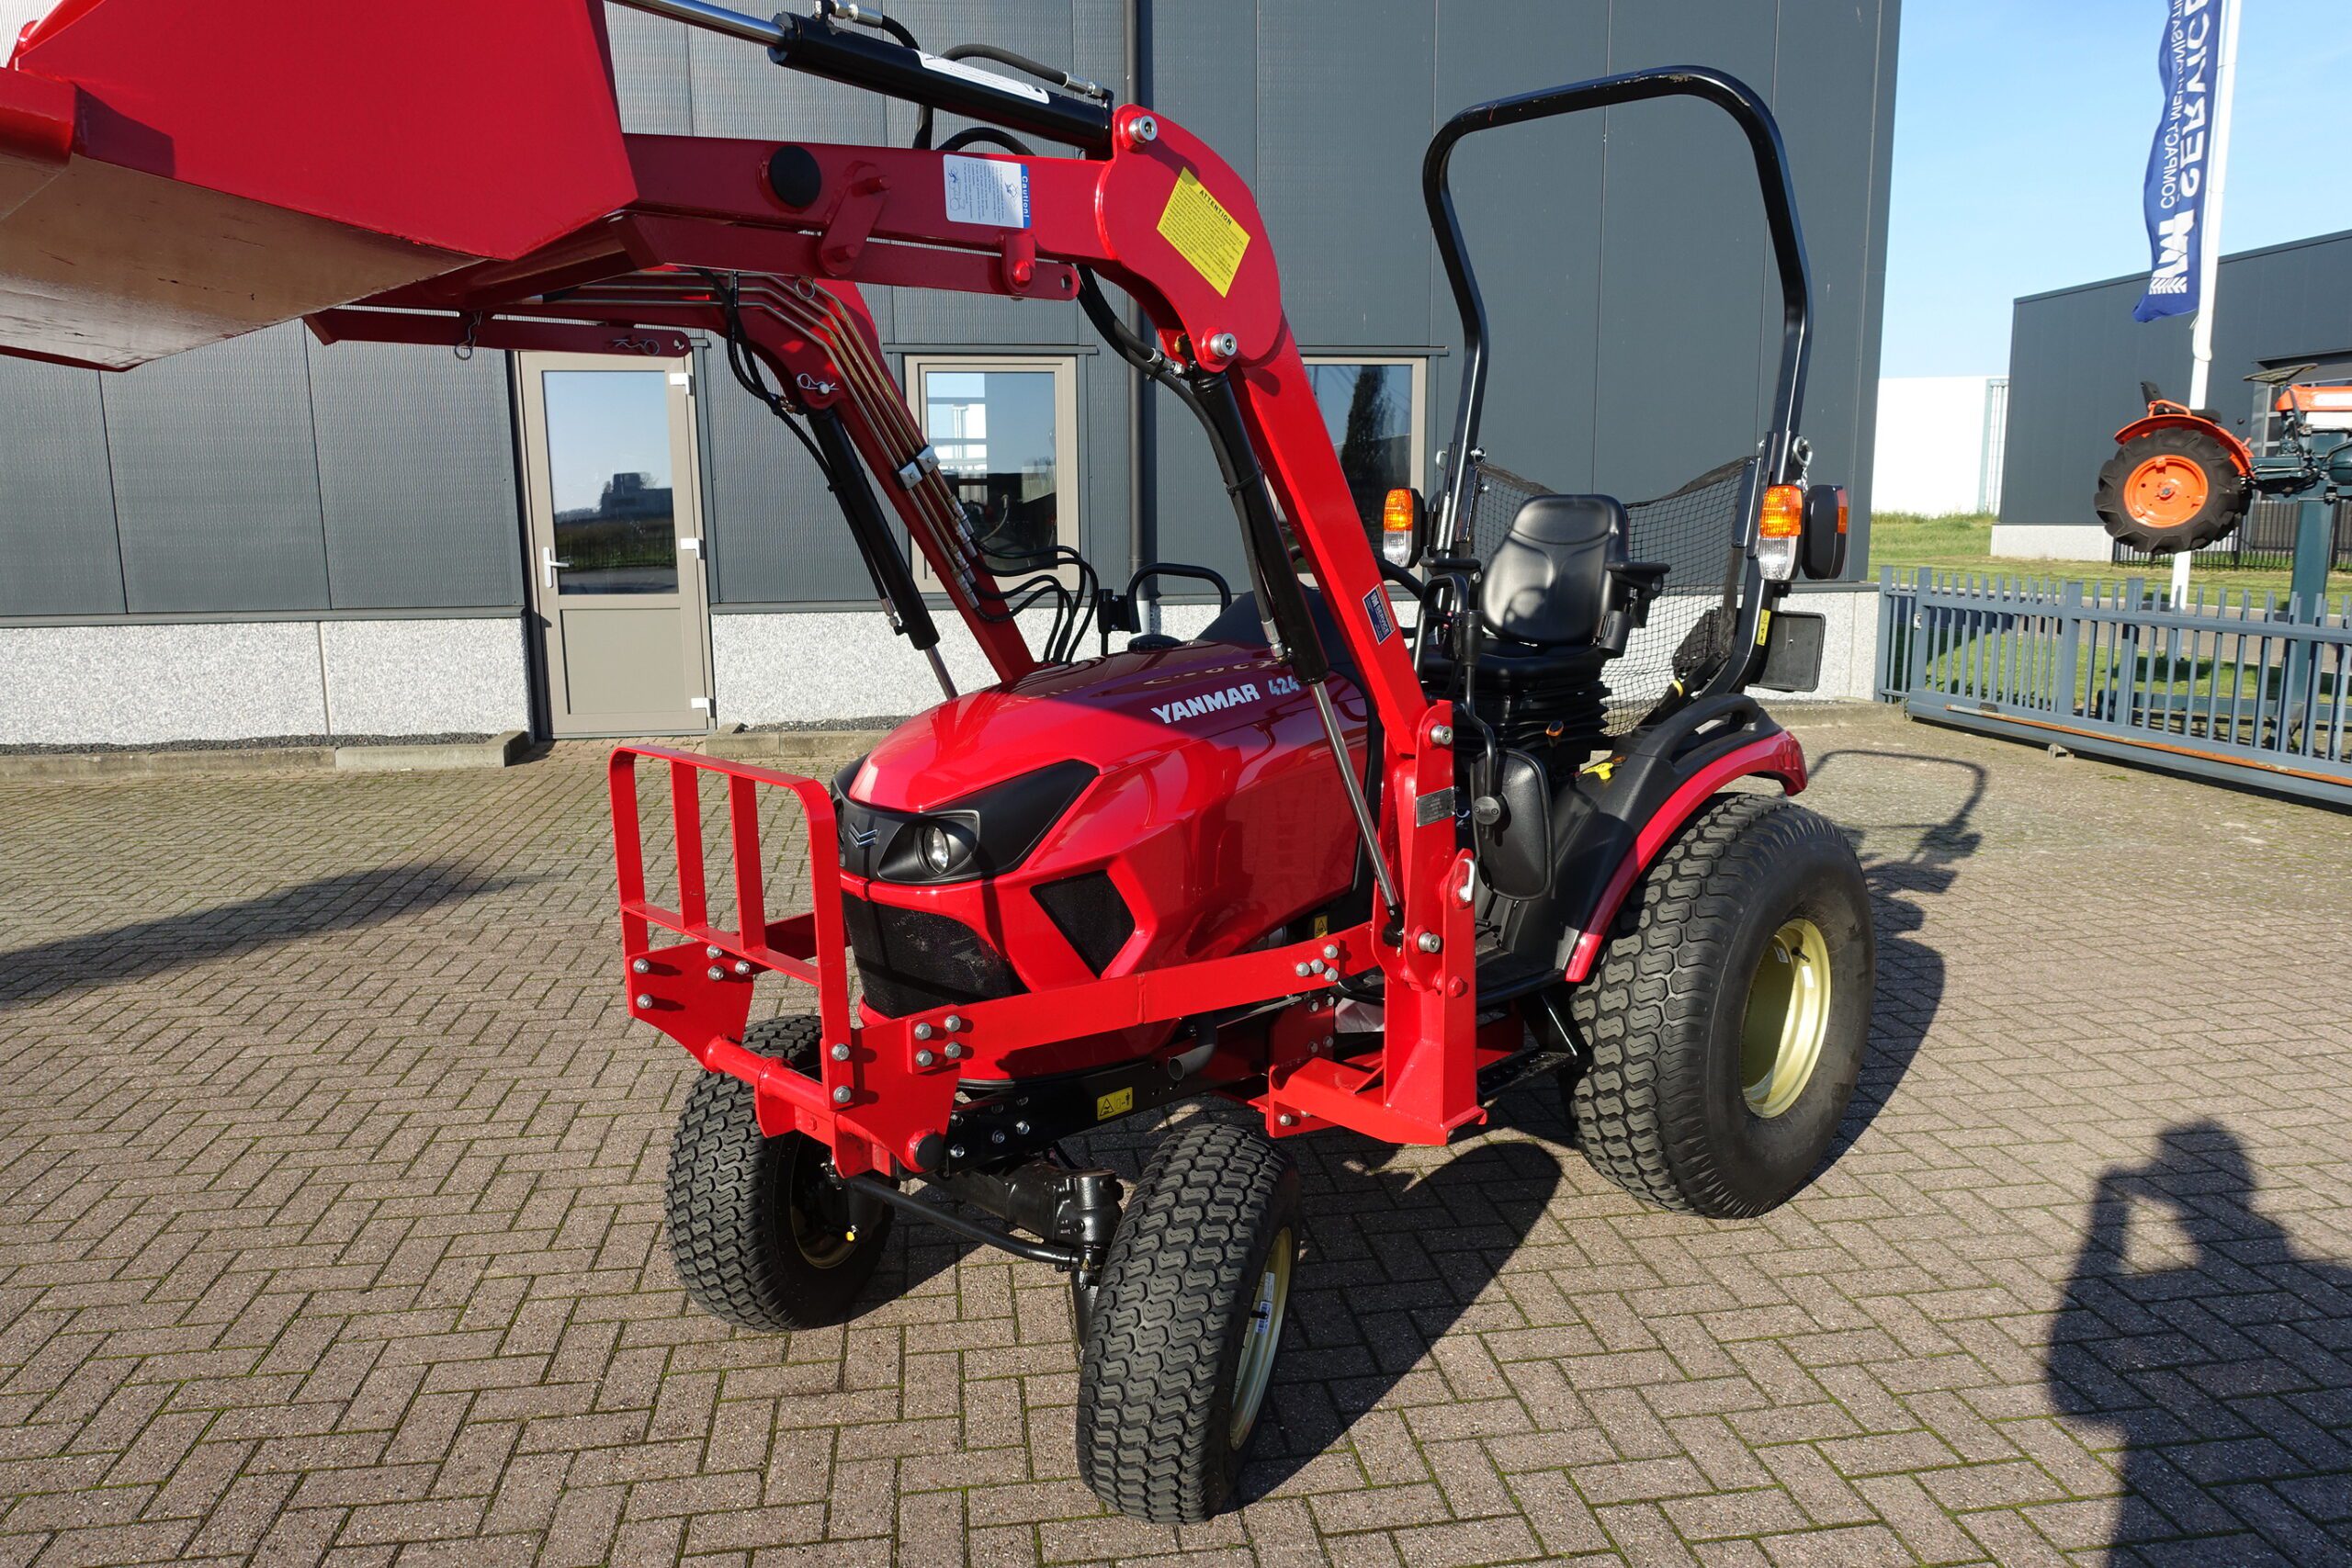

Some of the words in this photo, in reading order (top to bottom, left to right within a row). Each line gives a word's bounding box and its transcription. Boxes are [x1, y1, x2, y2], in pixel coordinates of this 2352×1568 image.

[1021, 175, 1029, 218] Caution!
[1198, 188, 1232, 226] ATTENTION
[1150, 682, 1261, 725] YANMAR
[1268, 675, 1301, 696] 424
